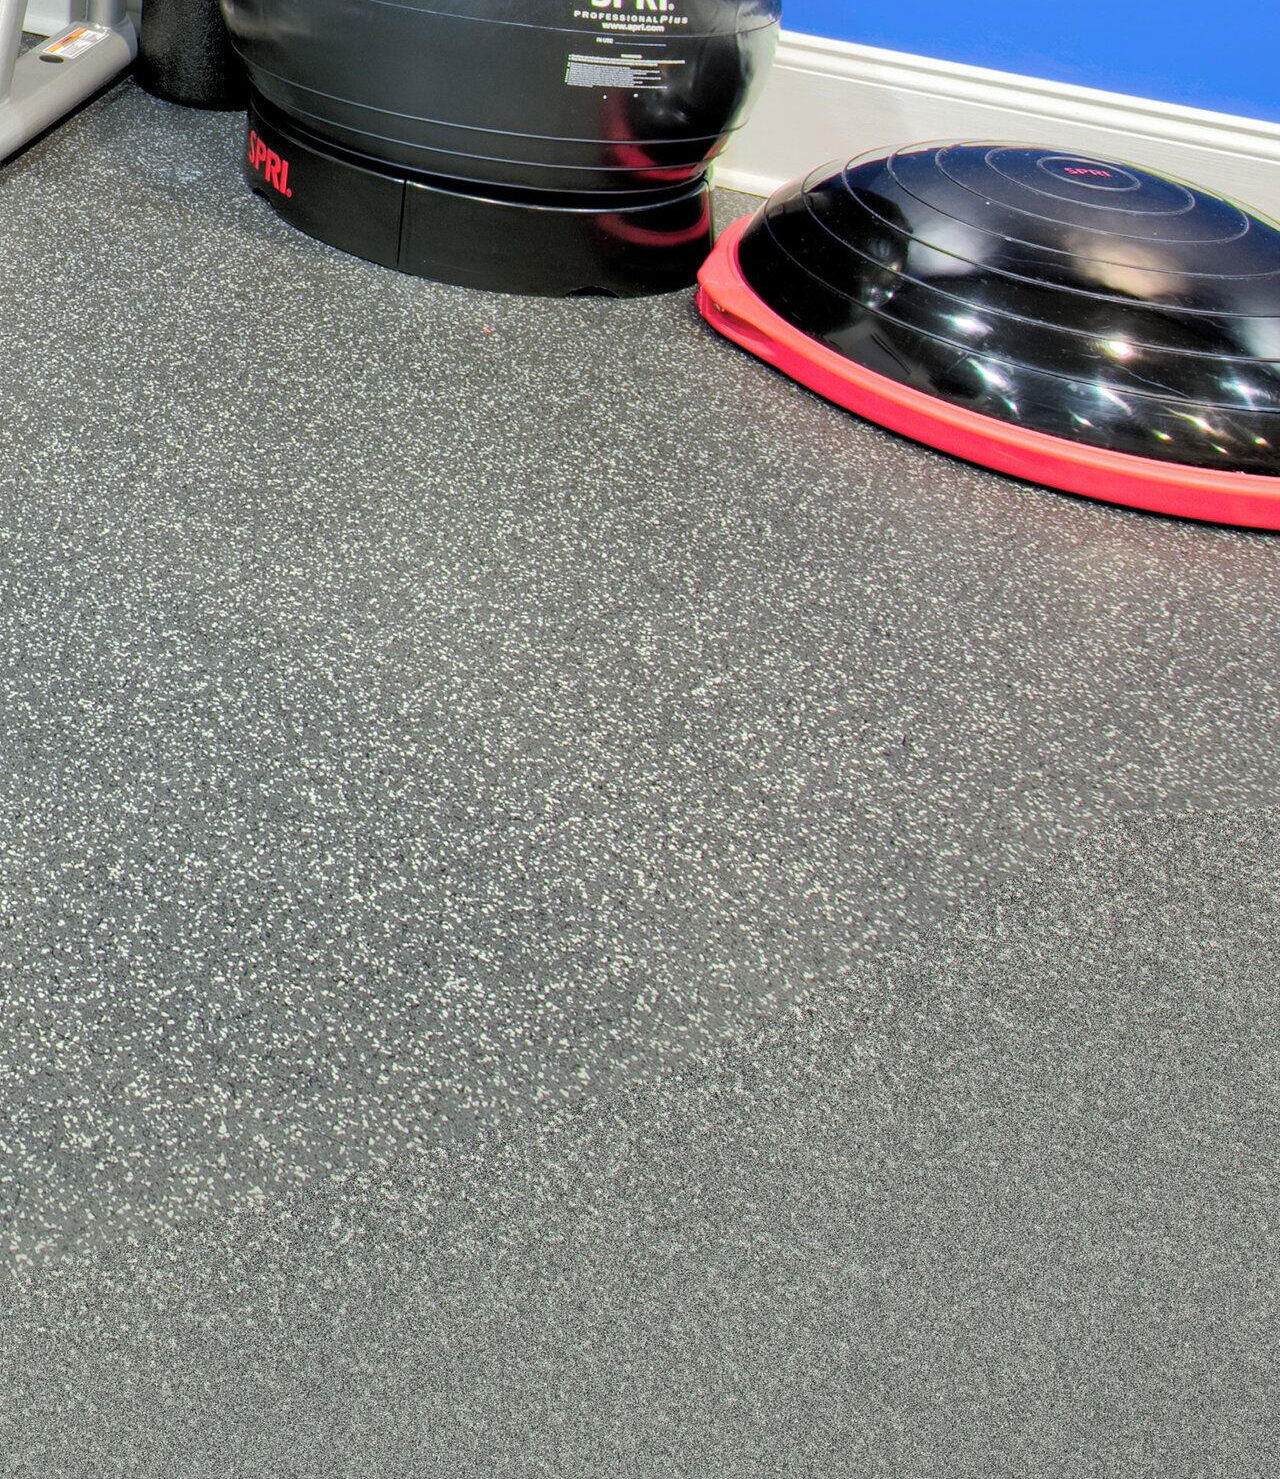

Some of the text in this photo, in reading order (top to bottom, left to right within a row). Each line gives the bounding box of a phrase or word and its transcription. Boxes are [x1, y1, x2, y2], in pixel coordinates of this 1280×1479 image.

[573, 10, 658, 23] PROFESSIONAL
[248, 129, 289, 195] SPRI
[1065, 168, 1111, 178] SPRI
